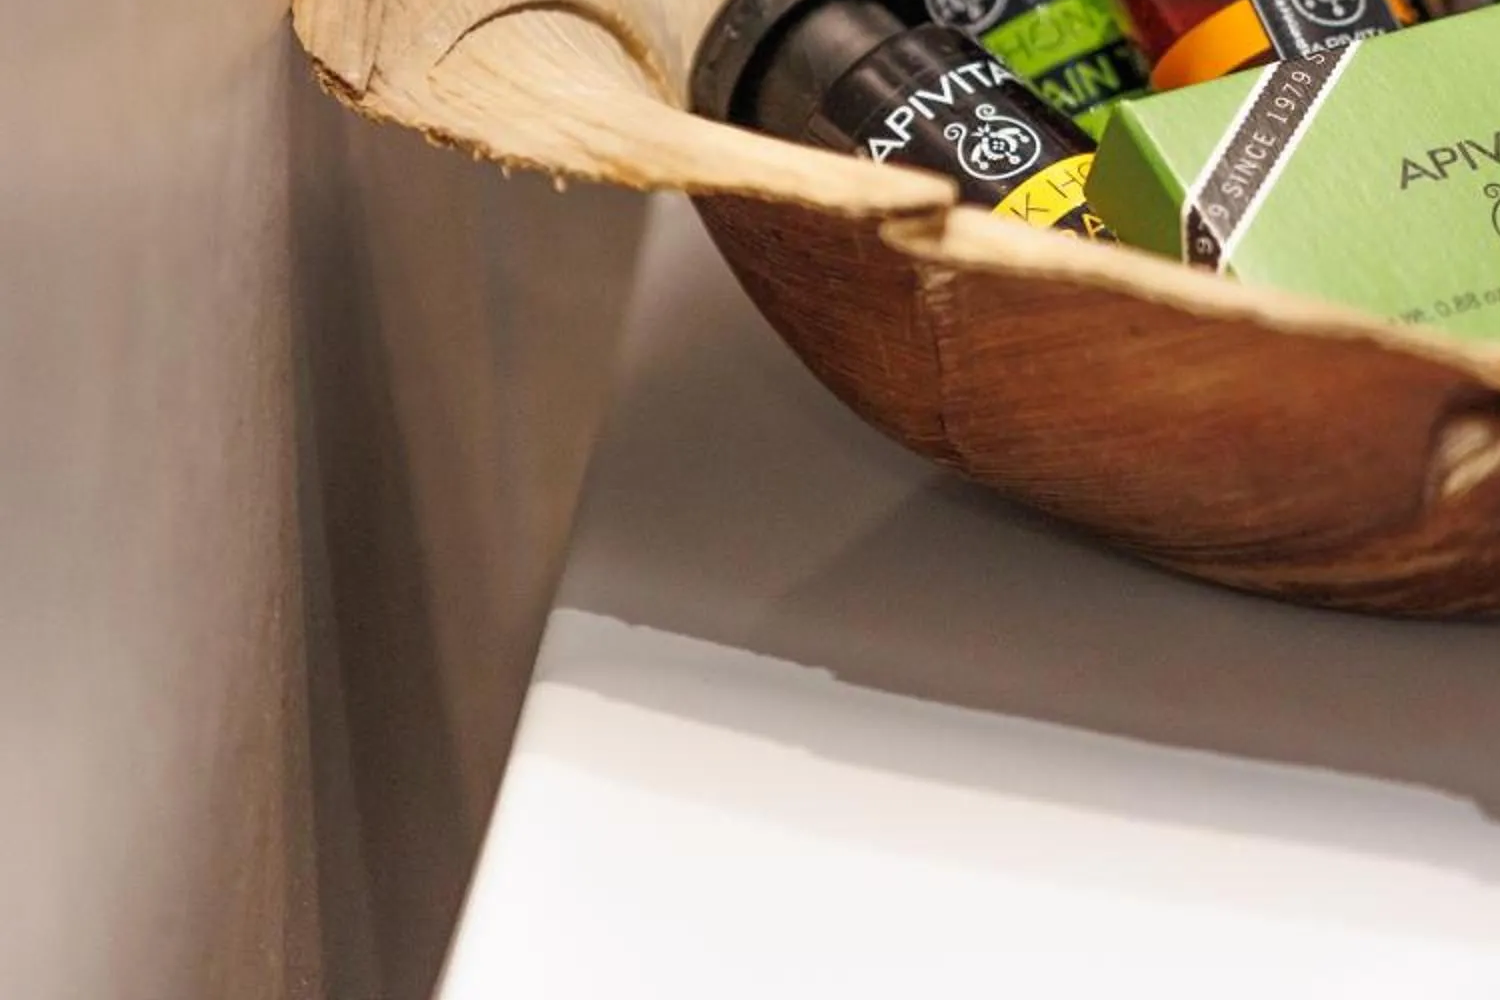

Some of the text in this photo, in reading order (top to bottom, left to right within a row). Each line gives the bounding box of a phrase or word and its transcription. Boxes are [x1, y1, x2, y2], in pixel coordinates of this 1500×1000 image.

[868, 59, 1016, 164] APIVITA
[1221, 131, 1277, 198] SINCE
[1265, 70, 1312, 124] 1979
